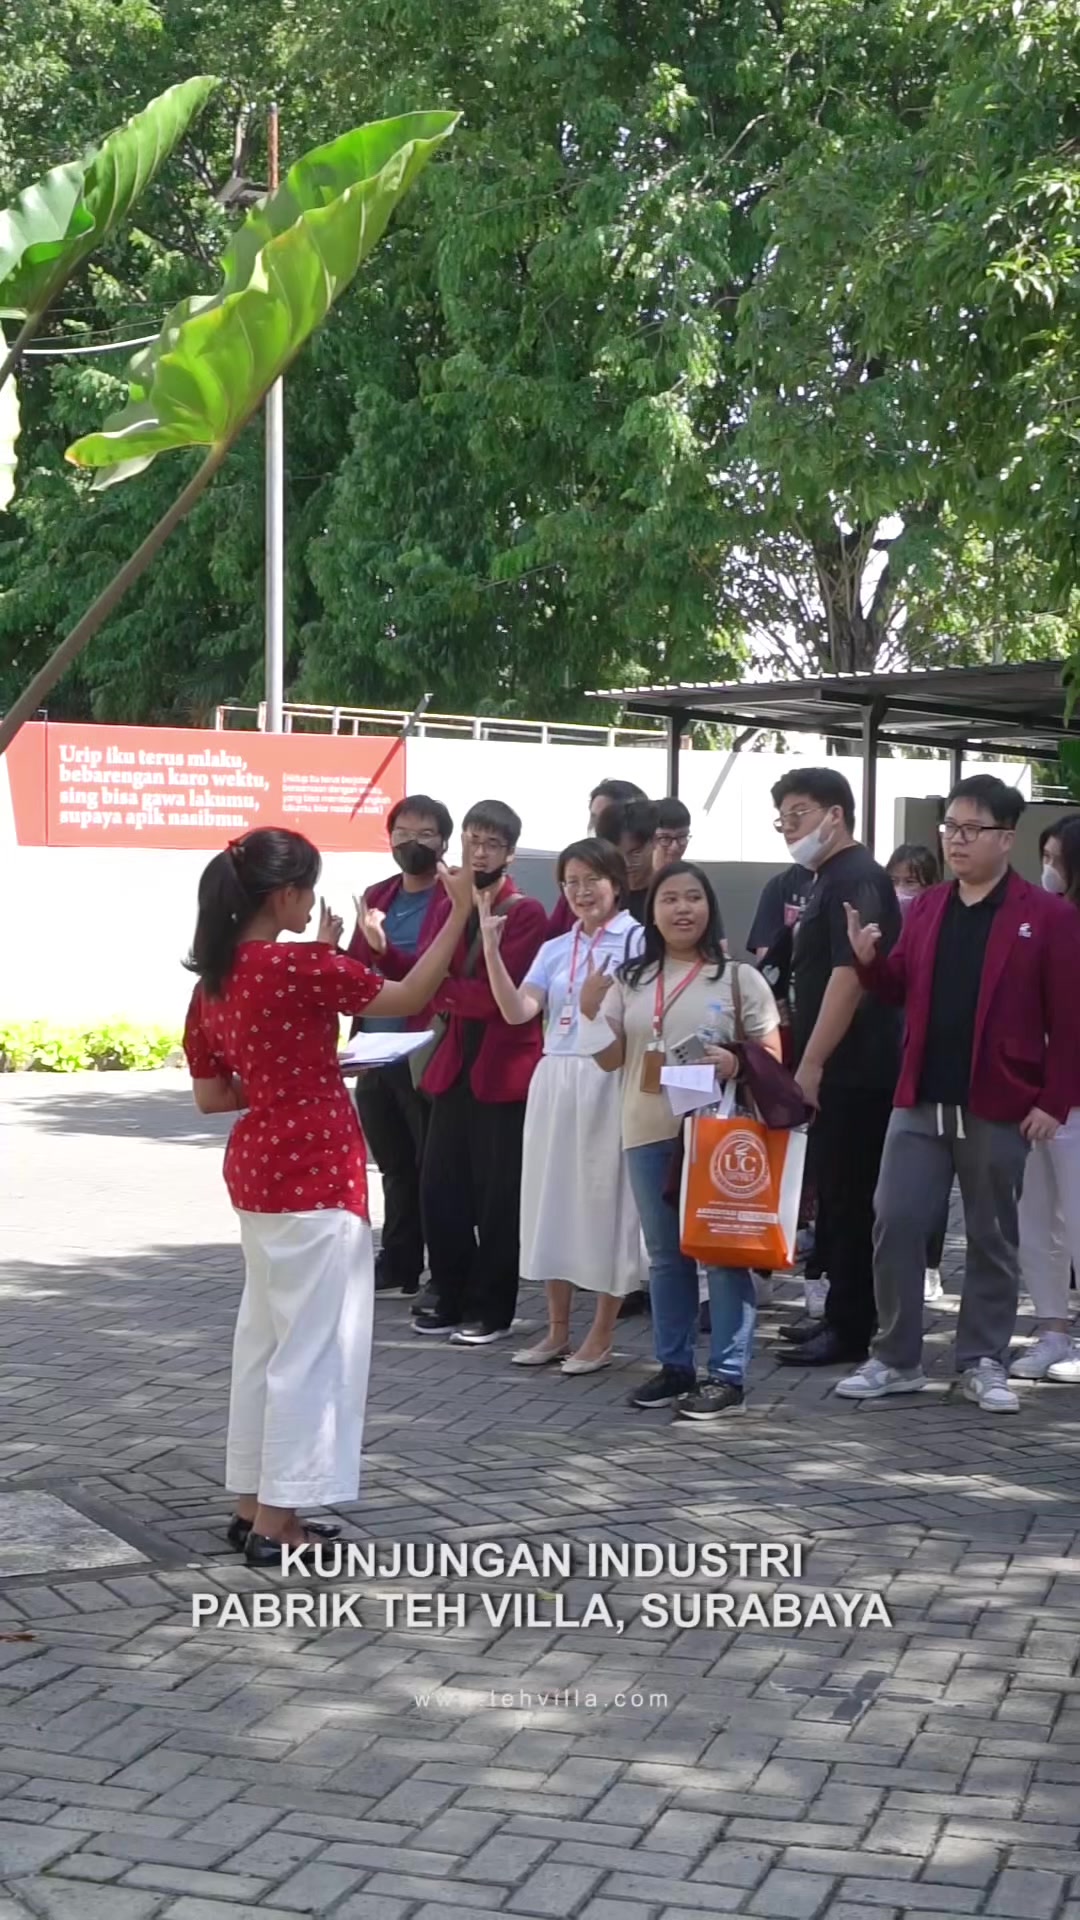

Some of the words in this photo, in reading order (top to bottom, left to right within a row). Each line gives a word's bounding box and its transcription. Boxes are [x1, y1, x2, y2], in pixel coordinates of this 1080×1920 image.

[59, 745, 101, 767] Urip
[106, 746, 134, 764] iku
[139, 750, 184, 766] terus
[187, 750, 247, 770] mlaku,
[59, 764, 164, 789] bebarengan
[168, 768, 208, 785] karo
[212, 771, 269, 791] wektu,
[59, 788, 98, 809] sing
[102, 787, 138, 805] bisa
[142, 793, 185, 810] gawa
[189, 790, 260, 811] lakumu,
[59, 810, 122, 828] supaya
[125, 809, 165, 829] apik
[168, 808, 249, 827] nasibmu.
[724, 1154, 757, 1173] UC
